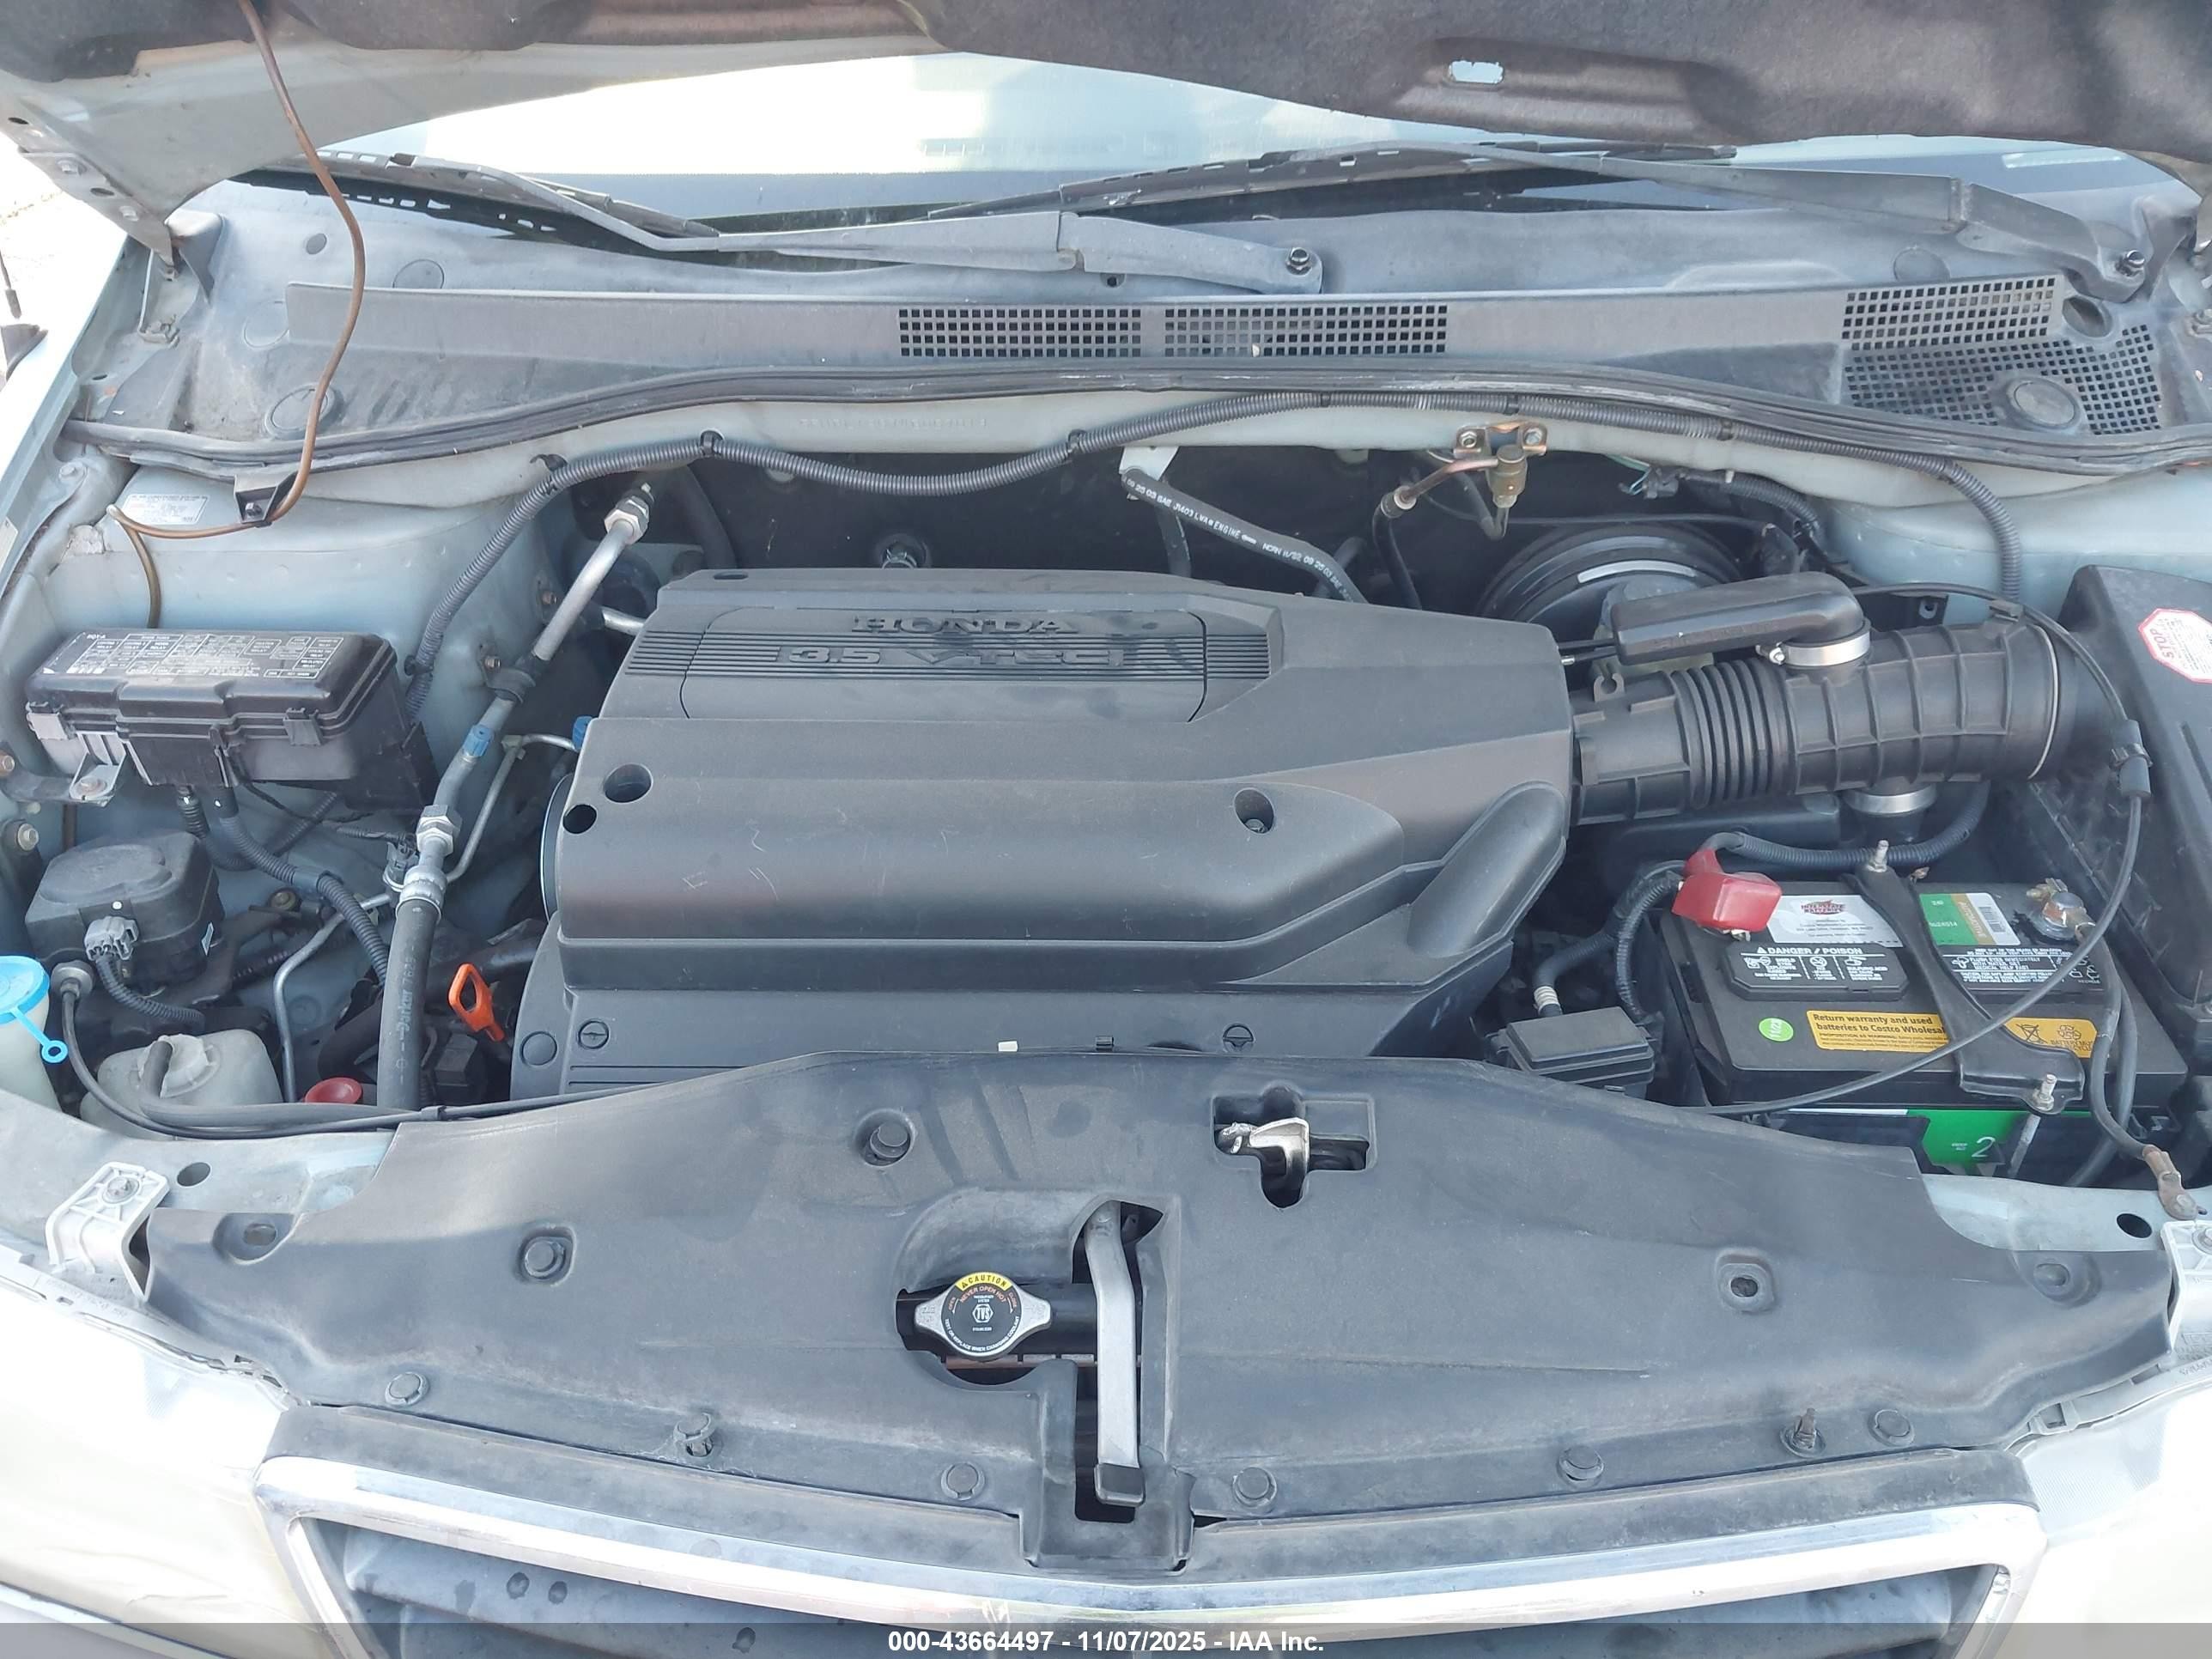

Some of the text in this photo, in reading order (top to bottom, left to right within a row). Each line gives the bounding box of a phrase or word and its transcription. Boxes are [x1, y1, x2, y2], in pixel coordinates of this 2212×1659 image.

[1213, 520, 1242, 539] ENGINE
[851, 617, 1079, 635] HONDA
[2149, 628, 2174, 659] STOP
[788, 647, 1110, 665] 3.5 VTEC
[1813, 1013, 1933, 1025] Return warranty and used
[1817, 1022, 1946, 1035] batteries to Costco Wholesal
[1971, 1136, 1996, 1158] 2
[968, 1274, 1007, 1287] CAUTION
[959, 1285, 1006, 1303] NEVER OPEN HOT
[976, 1307, 990, 1320] TVS
[1007, 1316, 1020, 1337] COOLANT
